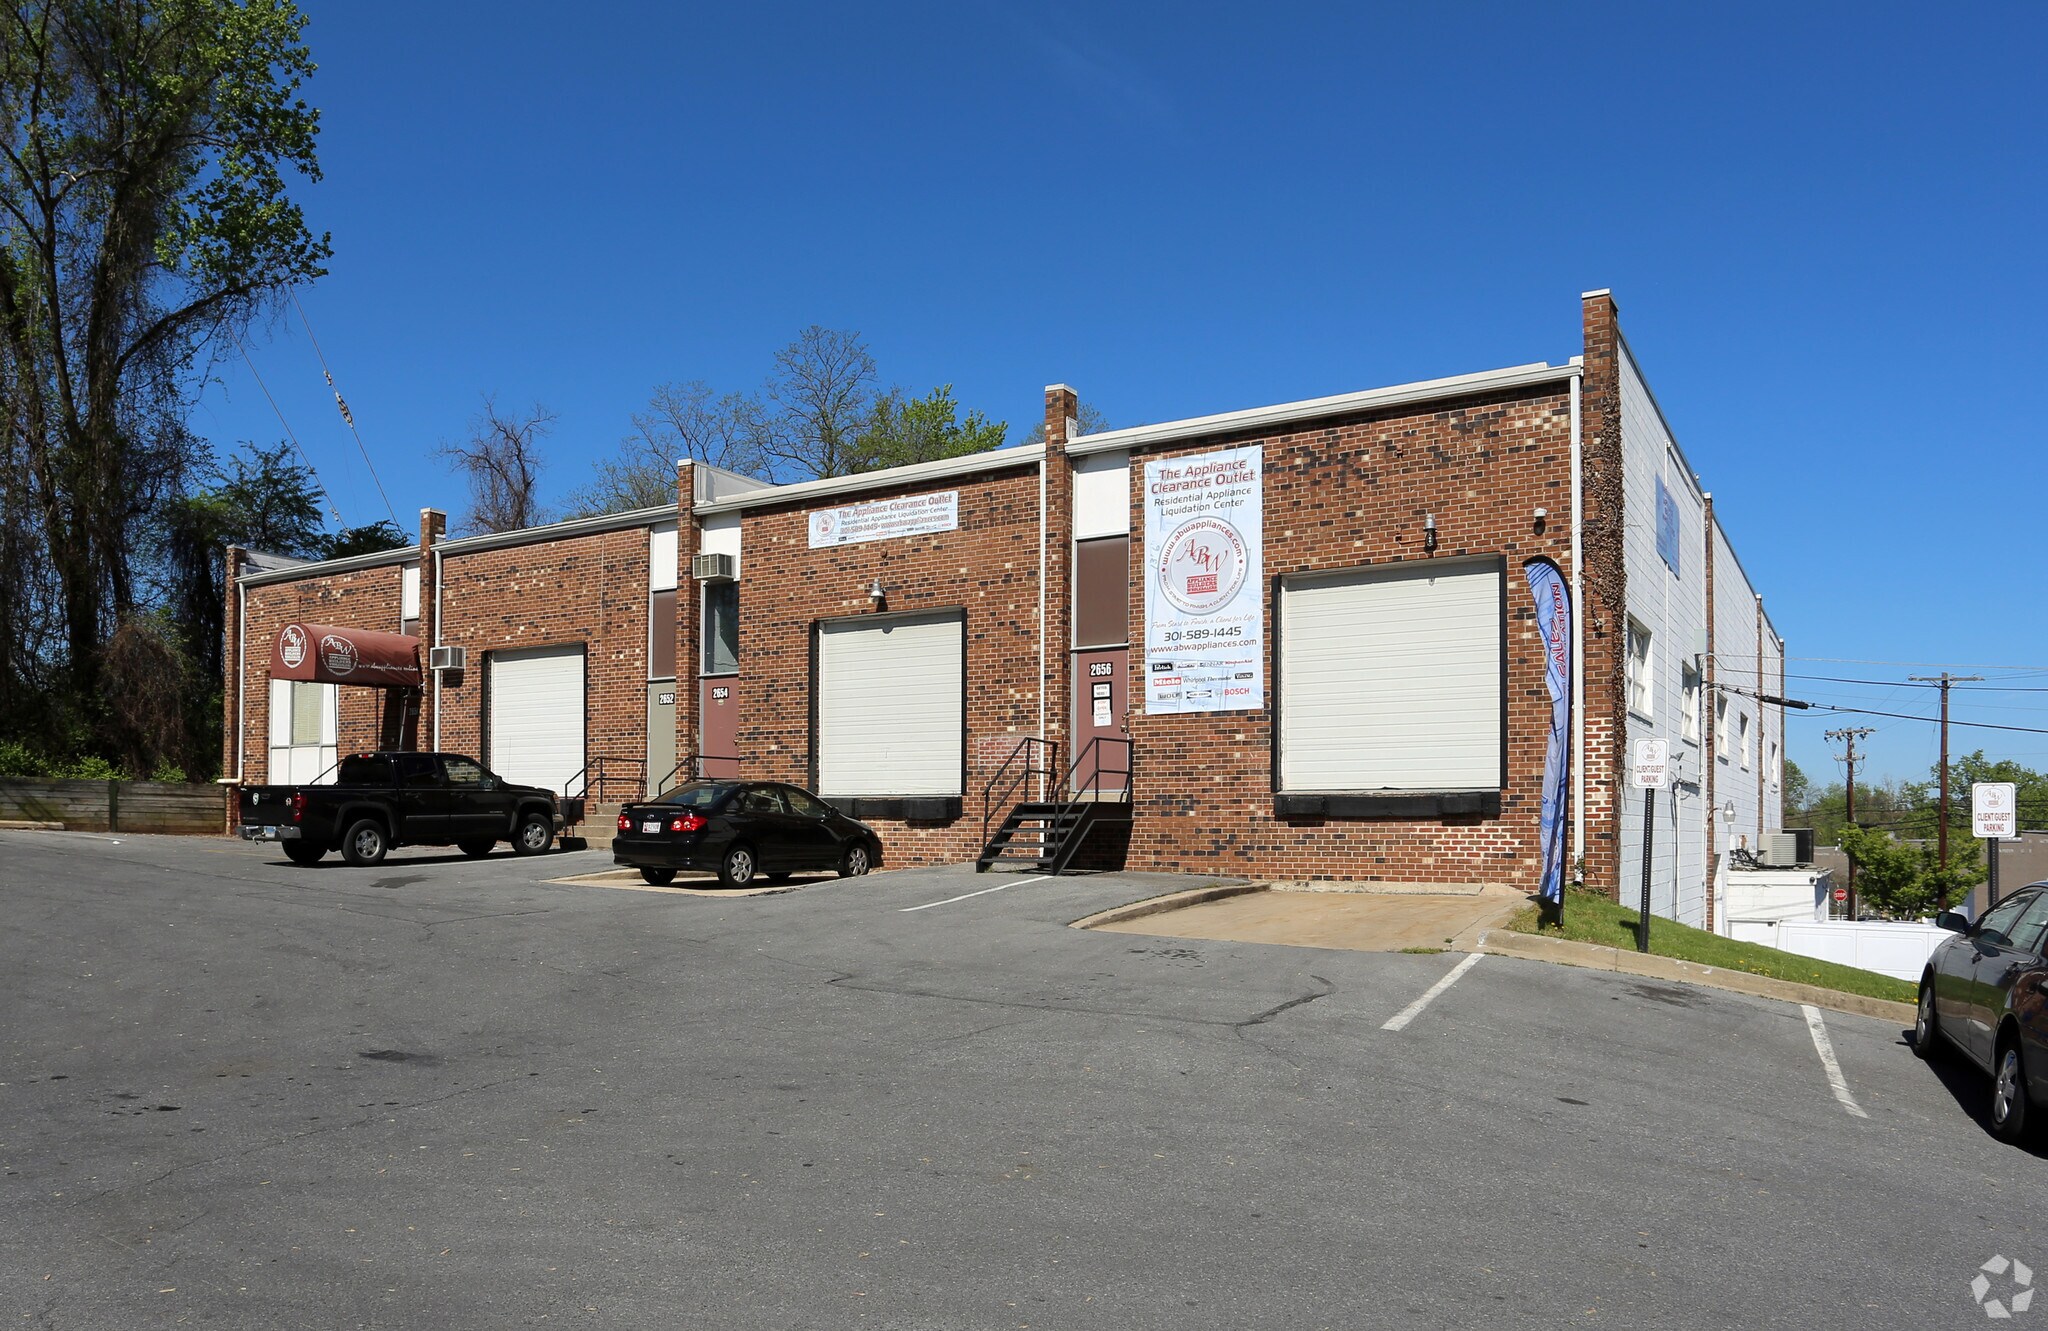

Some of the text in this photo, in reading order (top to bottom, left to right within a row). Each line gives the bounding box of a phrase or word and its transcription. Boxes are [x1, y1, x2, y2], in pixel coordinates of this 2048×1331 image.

[1160, 459, 1247, 480] The Appliance
[1152, 470, 1256, 494] Clearance Outlet
[1154, 488, 1251, 506] Residential Appliance
[838, 494, 952, 519] The Appliance Clearance Outlet
[1161, 499, 1244, 516] Liquidation Center
[841, 517, 869, 526] Residential
[870, 514, 896, 523] Appliance
[898, 508, 929, 518] Liquidation
[930, 506, 949, 514] Center
[1162, 520, 1244, 565] www.abwappliances.com
[1176, 539, 1229, 572] ABW
[1164, 626, 1242, 642] 301-589-1445
[325, 637, 352, 655] ABW
[1150, 638, 1257, 653] www.abwappliances.com
[1090, 663, 1112, 676] 2656
[1154, 677, 1181, 686] Miele
[659, 694, 674, 704] 2652
[713, 688, 728, 698] 2654
[1224, 688, 1249, 696] BOSCH
[1983, 823, 2004, 832] PARKING
